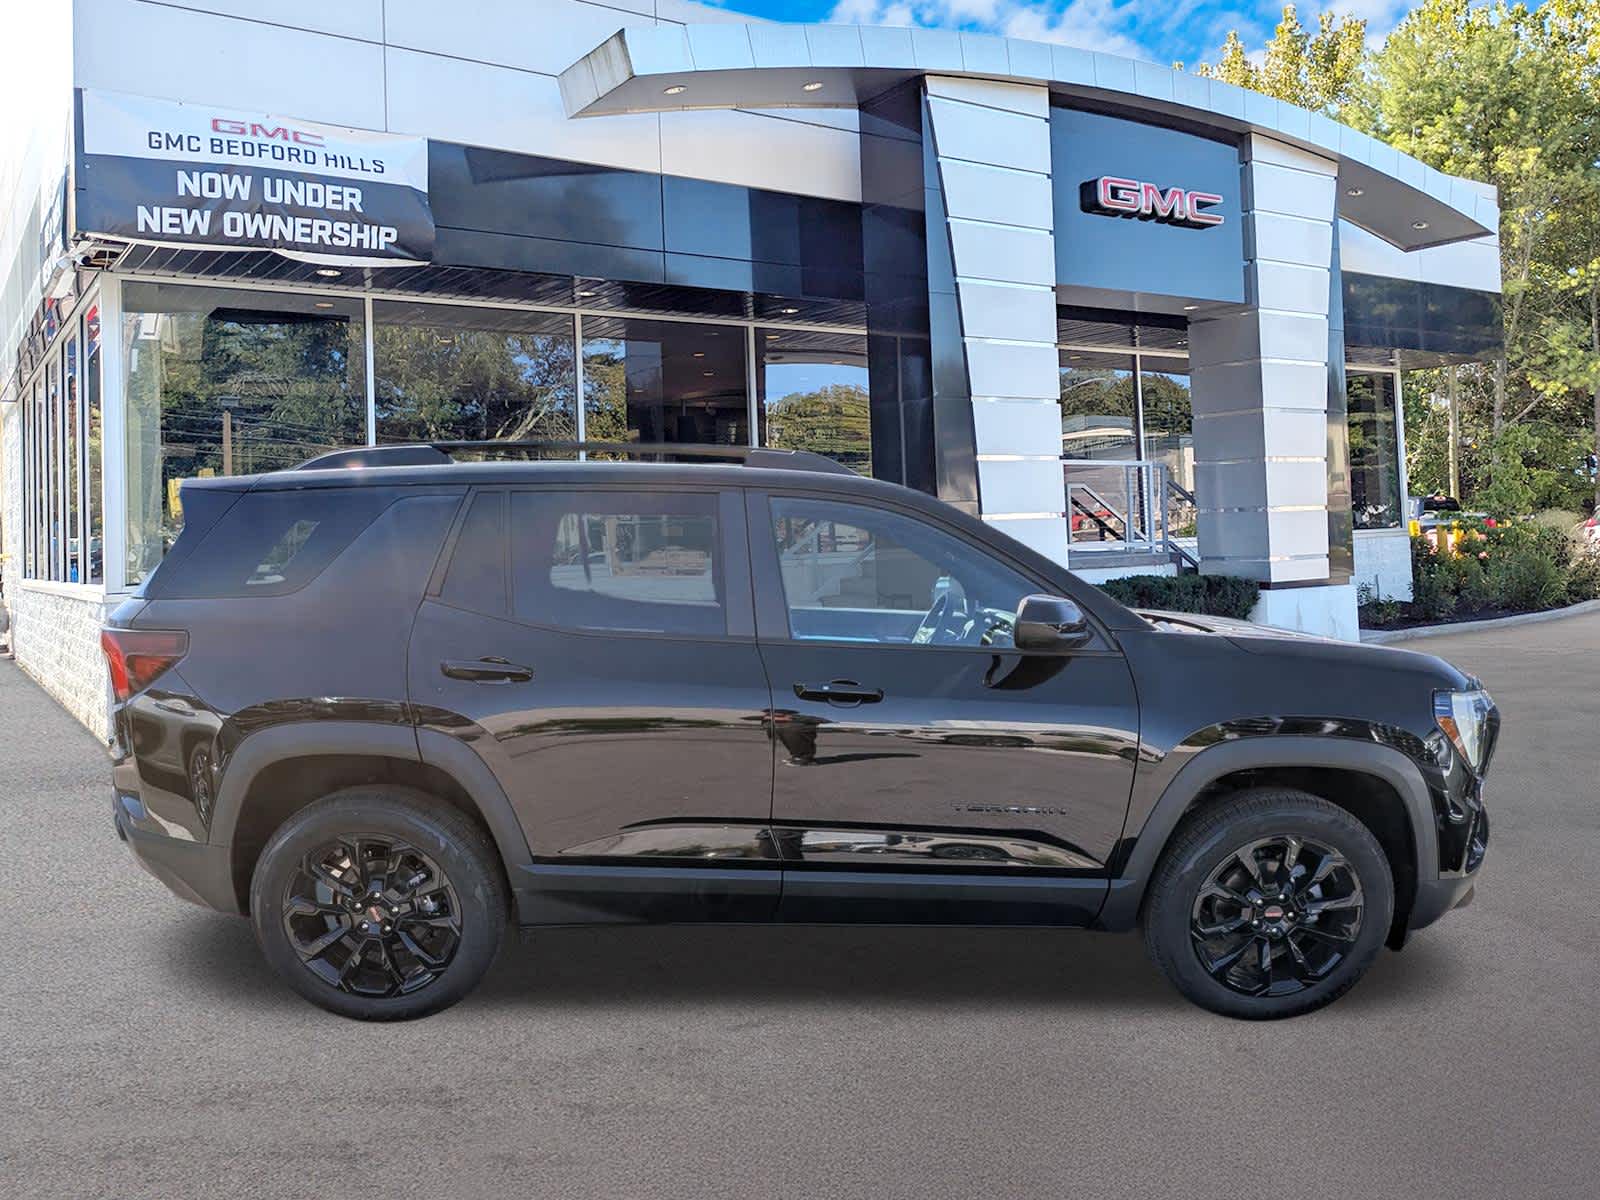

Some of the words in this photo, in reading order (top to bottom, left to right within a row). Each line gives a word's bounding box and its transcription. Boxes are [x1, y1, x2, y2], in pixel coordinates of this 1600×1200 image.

[148, 131, 201, 152] GMC
[209, 138, 316, 165] BEDFORD
[323, 152, 385, 173] HILLS
[211, 118, 326, 148] GMC
[176, 170, 252, 200] NOW
[263, 177, 363, 212] UNDER
[1097, 175, 1225, 225] GMC
[136, 205, 211, 235] NEW
[223, 211, 398, 249] OWNERSHIP
